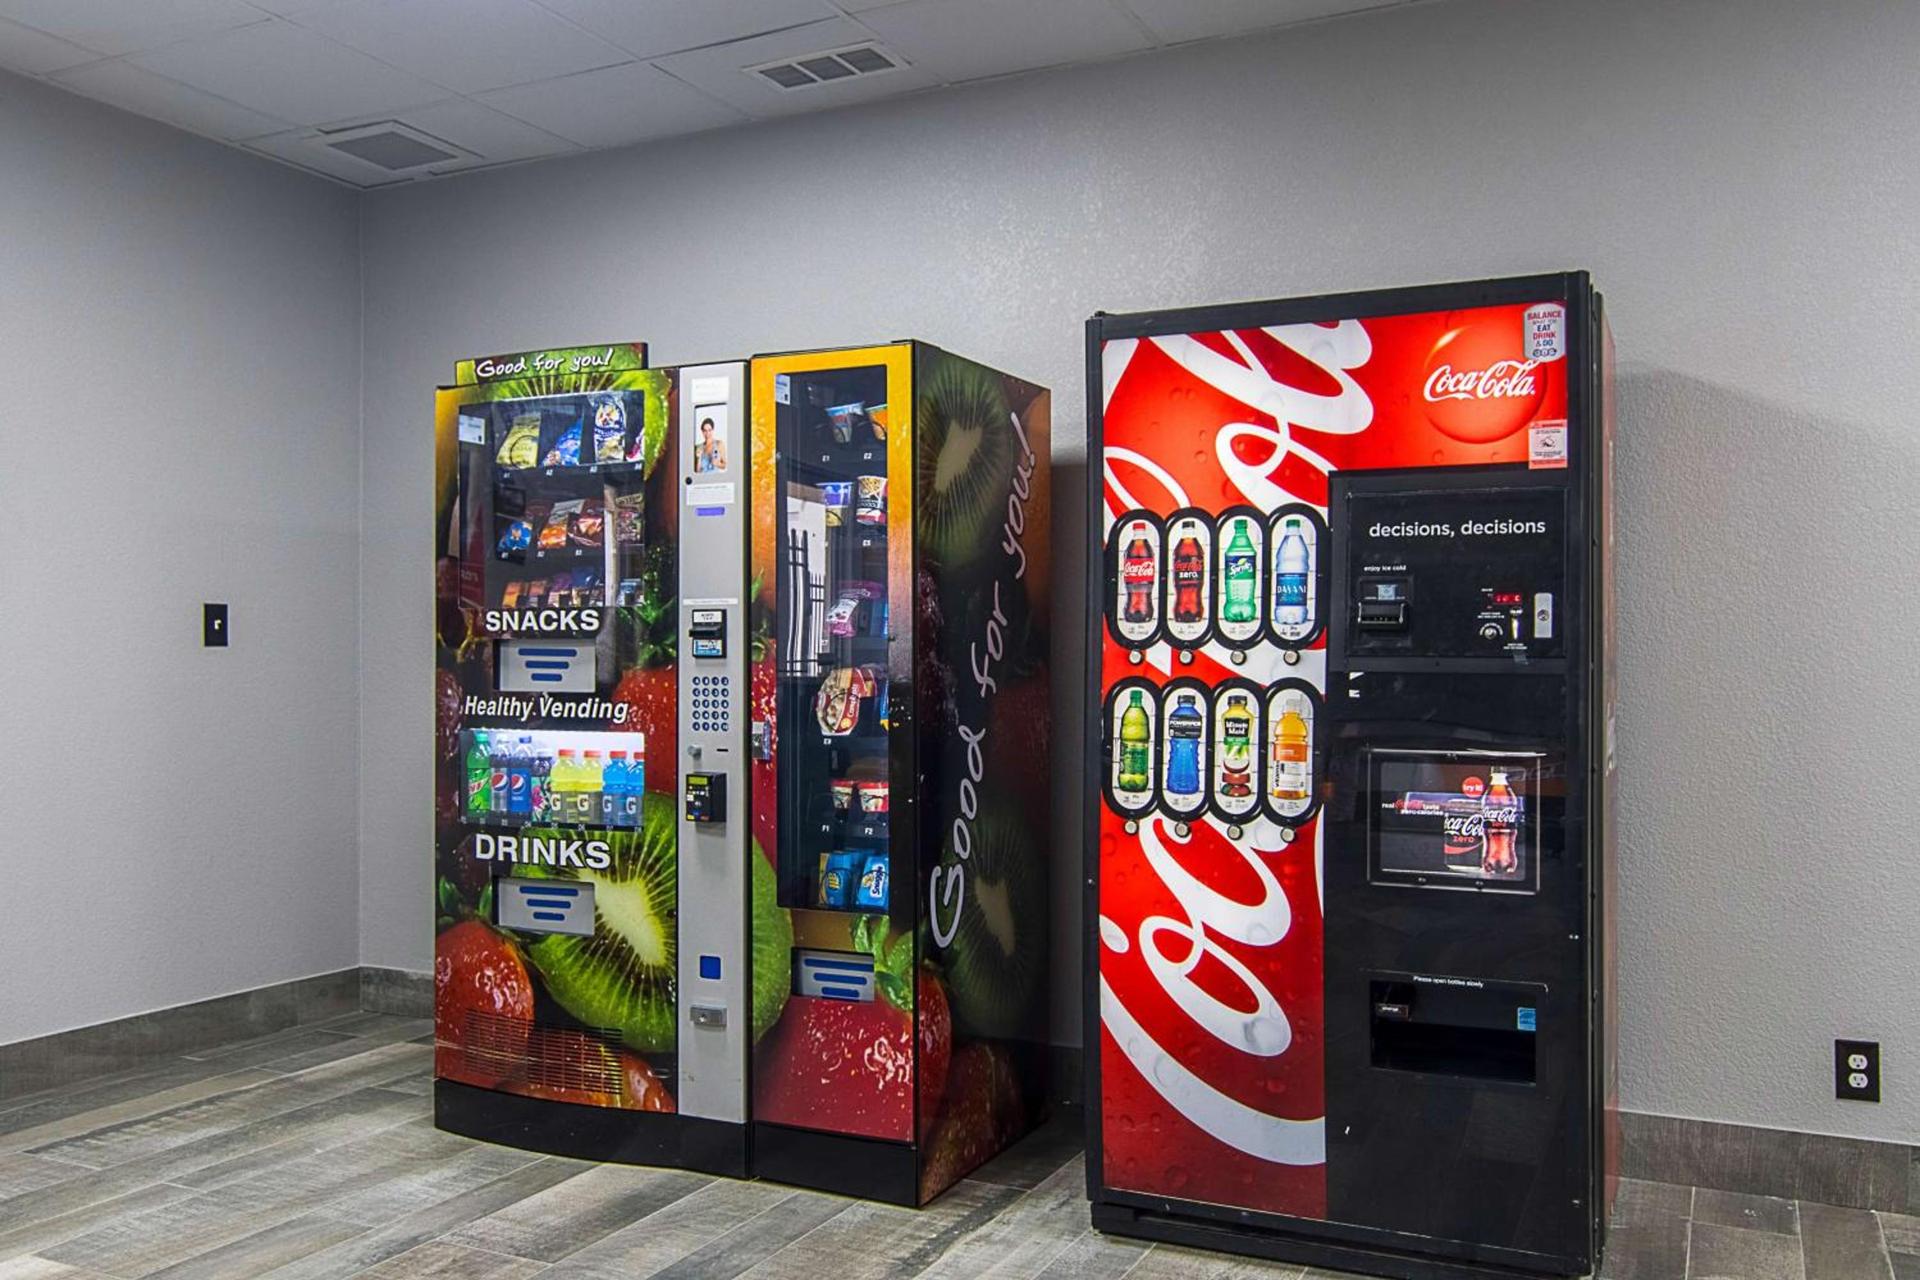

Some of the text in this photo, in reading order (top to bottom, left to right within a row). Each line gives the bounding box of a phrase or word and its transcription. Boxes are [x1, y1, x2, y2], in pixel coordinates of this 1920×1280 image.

[1527, 310, 1562, 320] BALANCE
[1533, 331, 1557, 340] DRINK
[1537, 324, 1551, 332] EAT
[476, 346, 614, 377] Good for you!
[1368, 519, 1546, 538] decisions, decisions
[485, 609, 600, 632] SNACKS
[929, 411, 1036, 948] Good for you!
[464, 695, 630, 725] Healthy Vending
[1225, 720, 1249, 729] Minute
[1227, 727, 1246, 735] Maid
[551, 793, 562, 811] G
[576, 793, 590, 812] G
[602, 795, 613, 813] G
[625, 796, 637, 815] G
[821, 824, 830, 832] F1
[864, 827, 873, 835] F2
[474, 833, 612, 869] DRINKS
